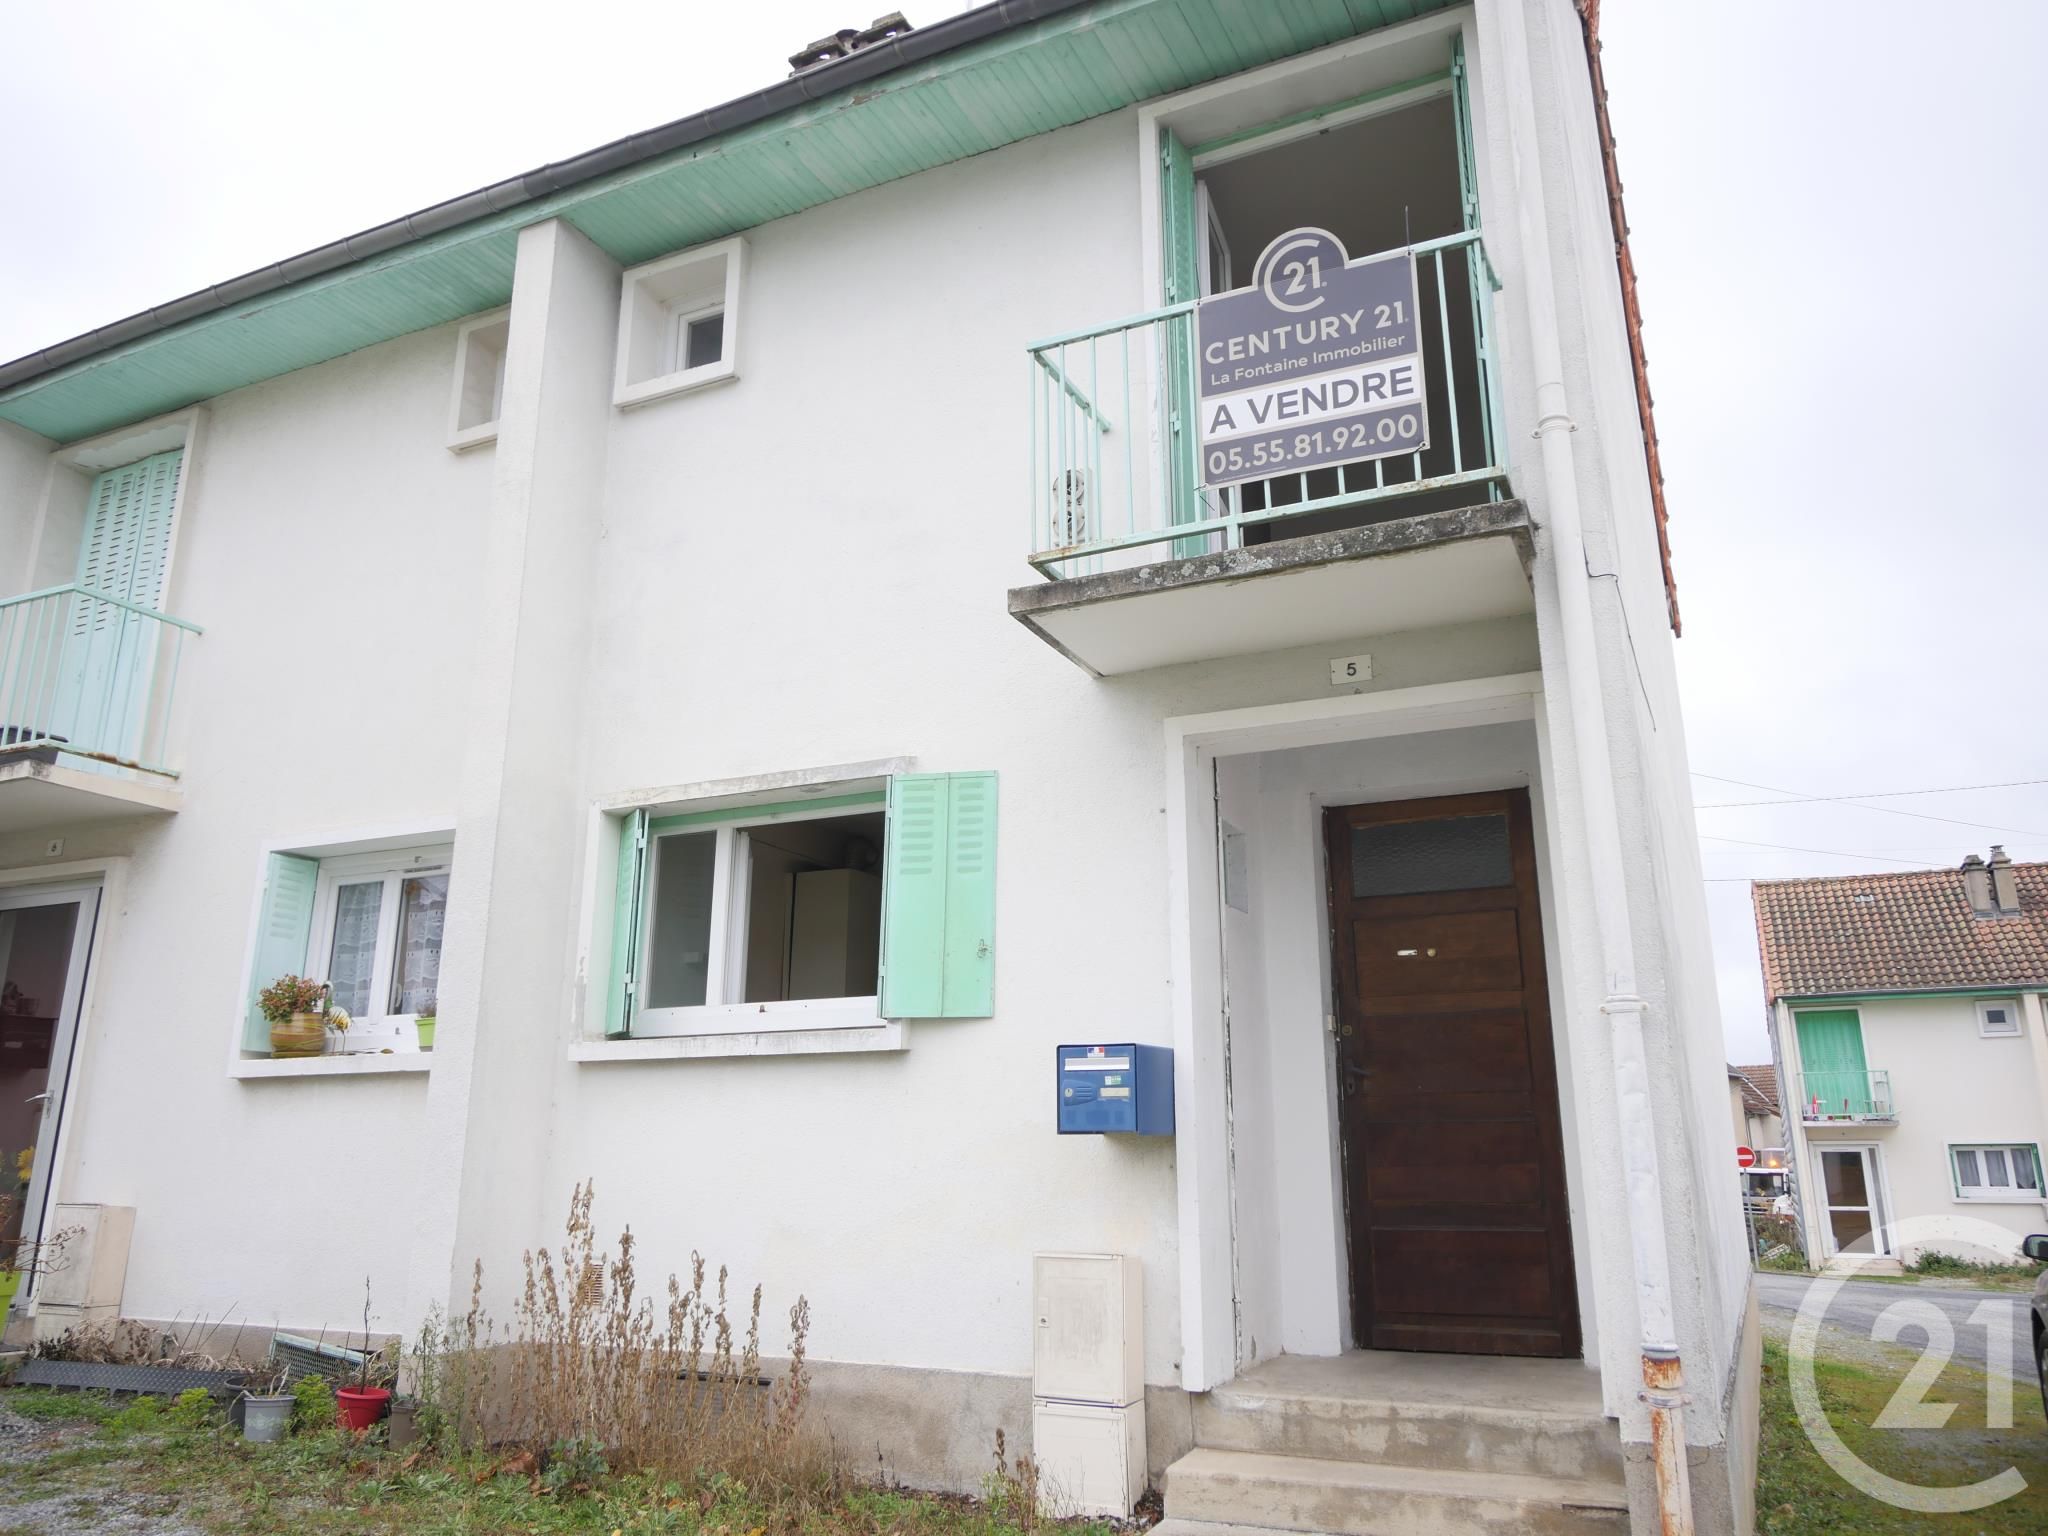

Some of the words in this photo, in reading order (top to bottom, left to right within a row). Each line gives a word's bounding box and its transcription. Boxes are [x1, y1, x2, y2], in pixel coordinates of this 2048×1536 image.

[1205, 309, 1364, 364] CENTURY
[1374, 301, 1405, 329] 21
[1211, 373, 1230, 386] La
[1235, 357, 1308, 381] Fontaine
[1313, 335, 1406, 364] Immobilier
[1209, 404, 1237, 434] A
[1247, 365, 1415, 425] VENDRE
[1209, 414, 1418, 475] 05.55.81.92.00
[1346, 662, 1357, 677] 5
